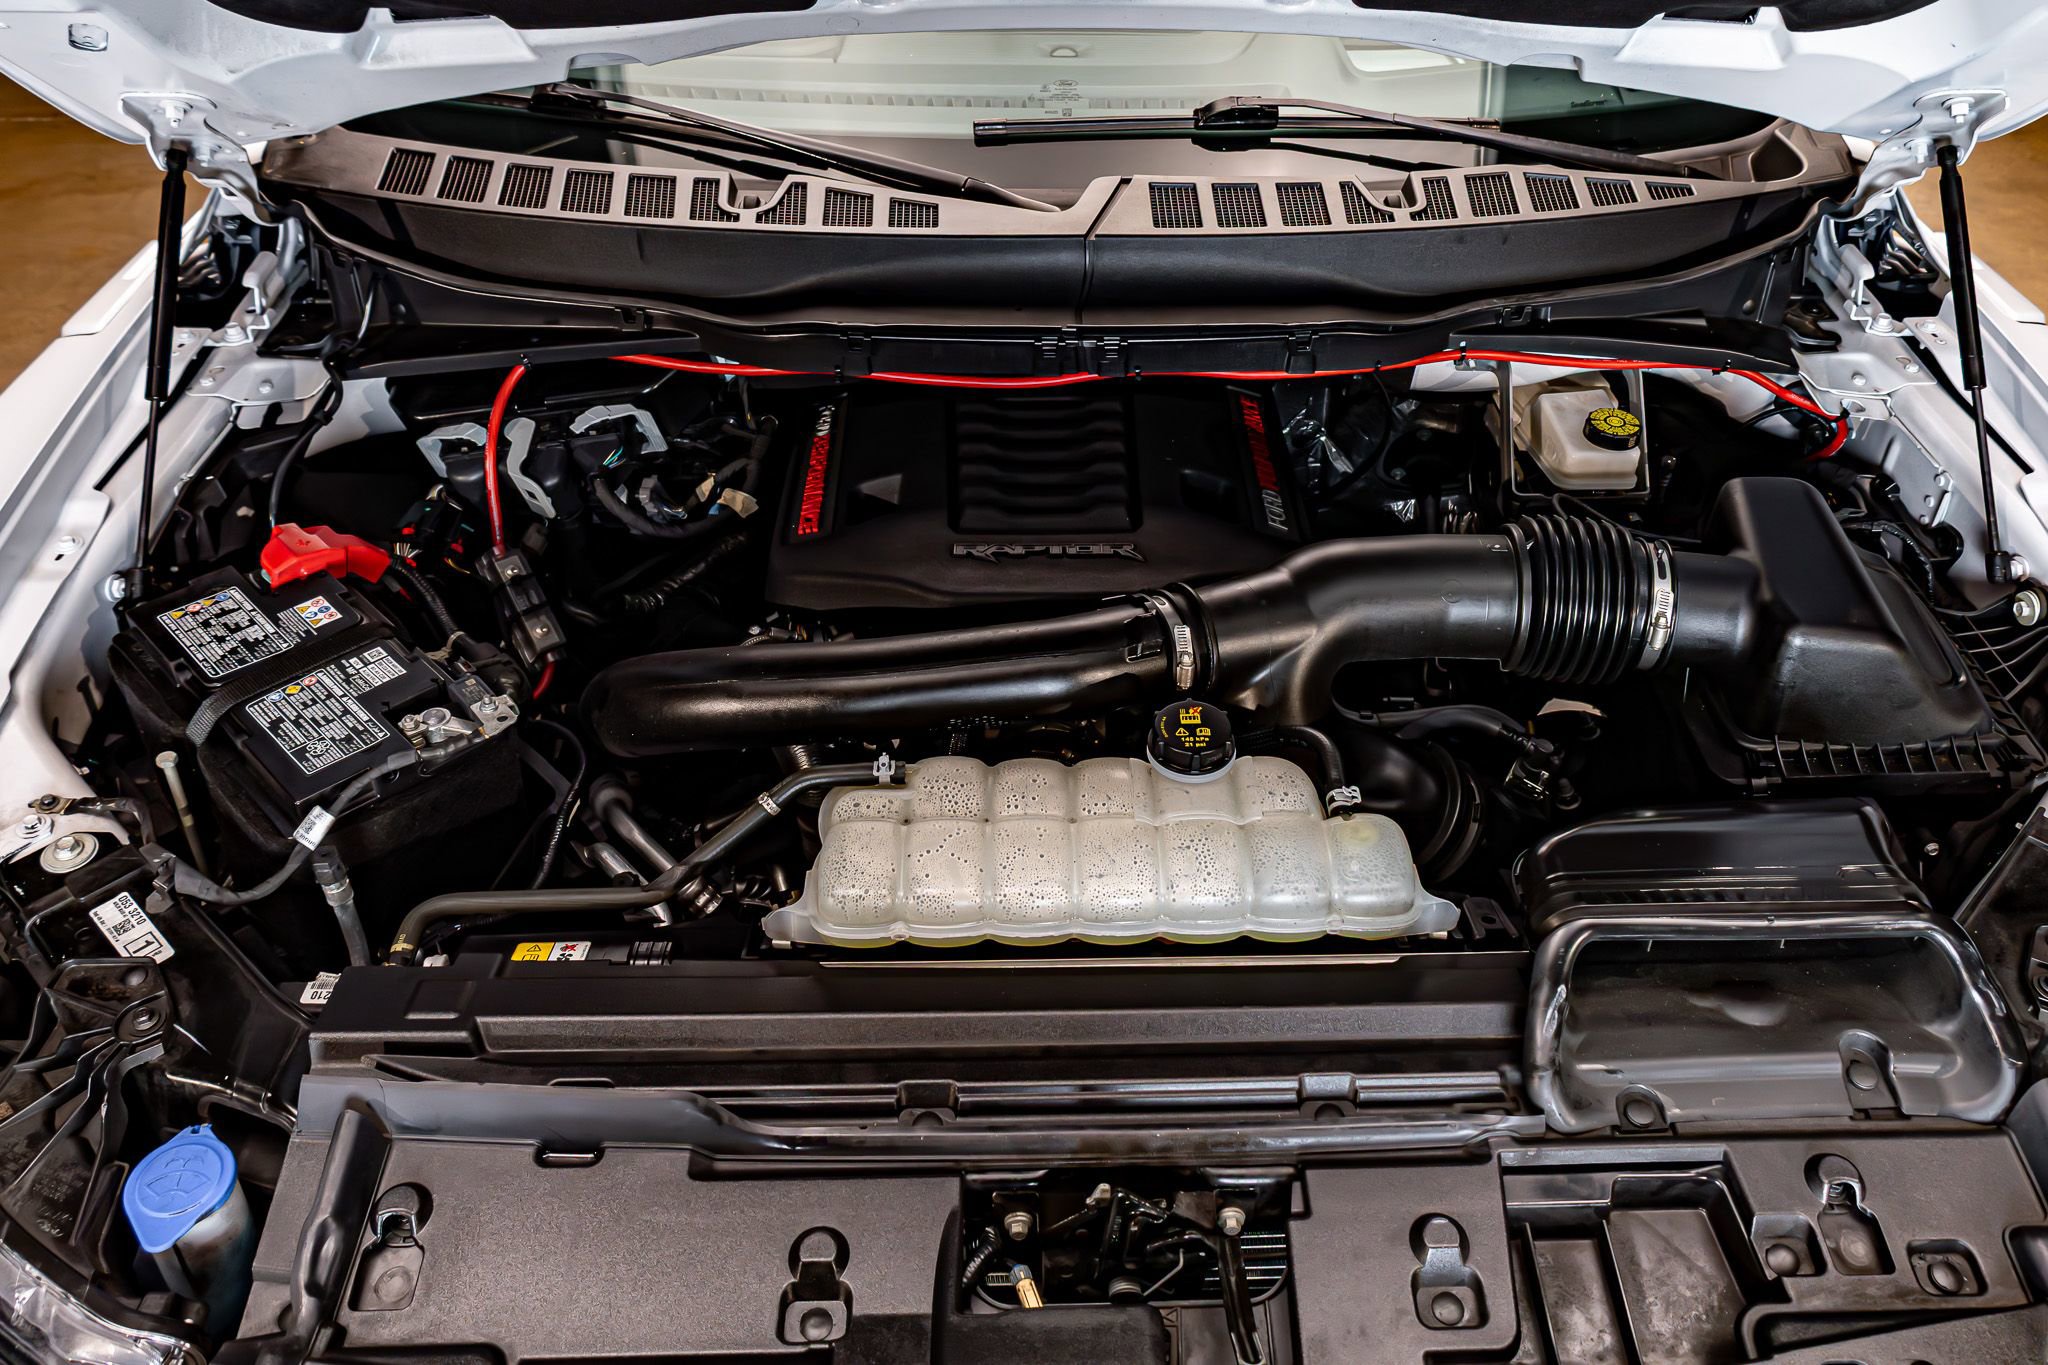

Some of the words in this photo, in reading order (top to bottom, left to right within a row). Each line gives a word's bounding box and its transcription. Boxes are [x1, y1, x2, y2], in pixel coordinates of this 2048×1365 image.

[1262, 489, 1288, 530] FORD
[953, 543, 1145, 563] RAPTOR
[118, 895, 133, 909] 053
[128, 908, 147, 926] 3210
